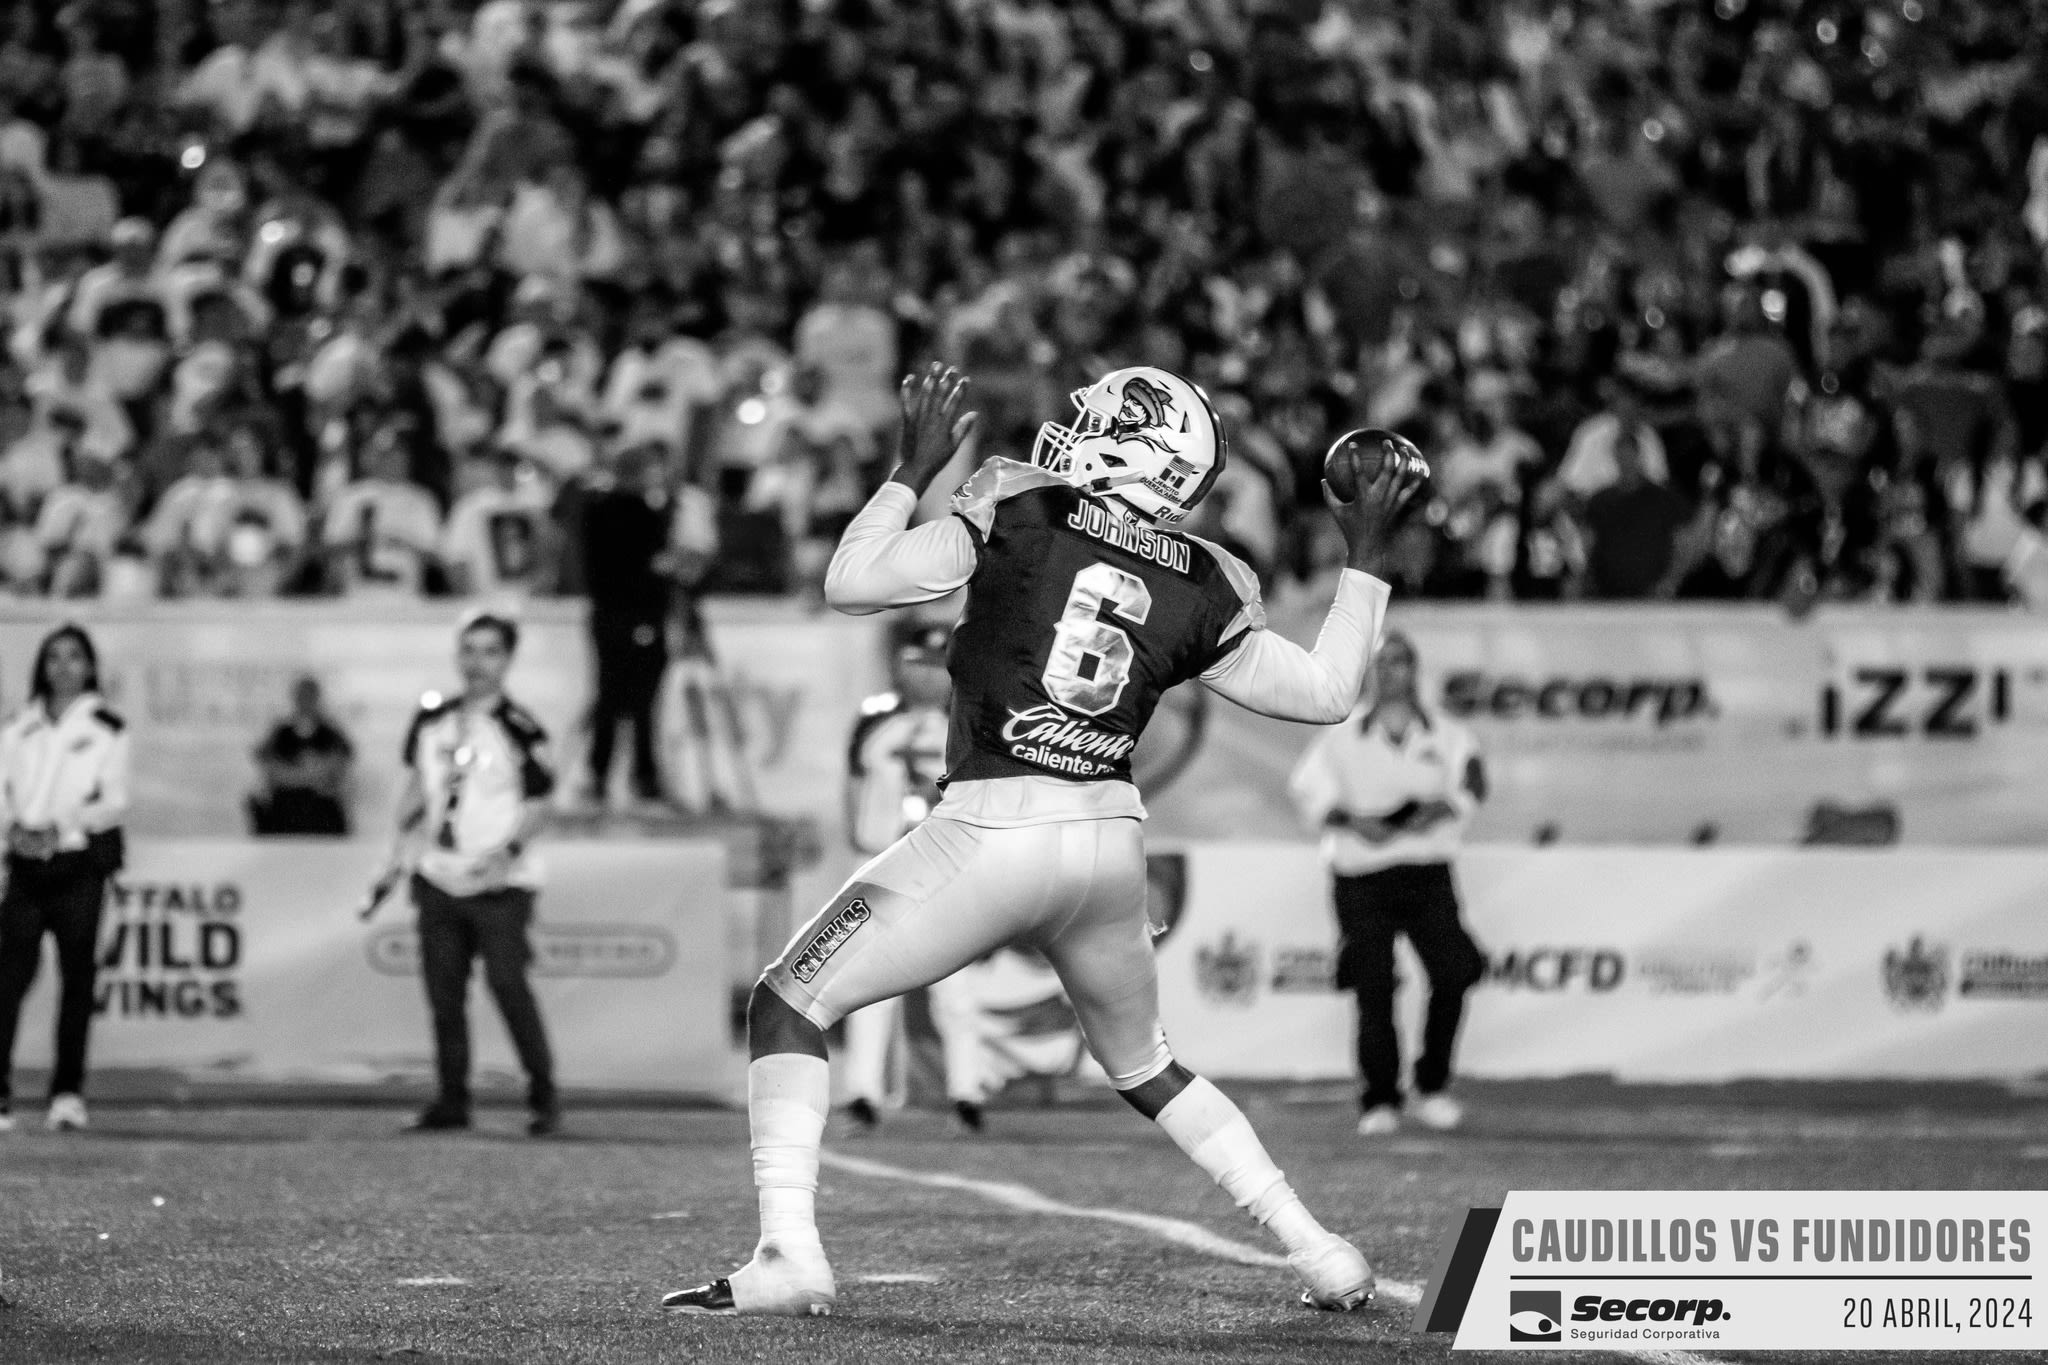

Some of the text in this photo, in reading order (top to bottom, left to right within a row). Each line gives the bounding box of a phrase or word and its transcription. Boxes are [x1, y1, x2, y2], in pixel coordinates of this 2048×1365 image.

[1067, 498, 1191, 575] JOHNSON
[1042, 562, 1152, 716] 6
[1002, 702, 1135, 760] Caliente
